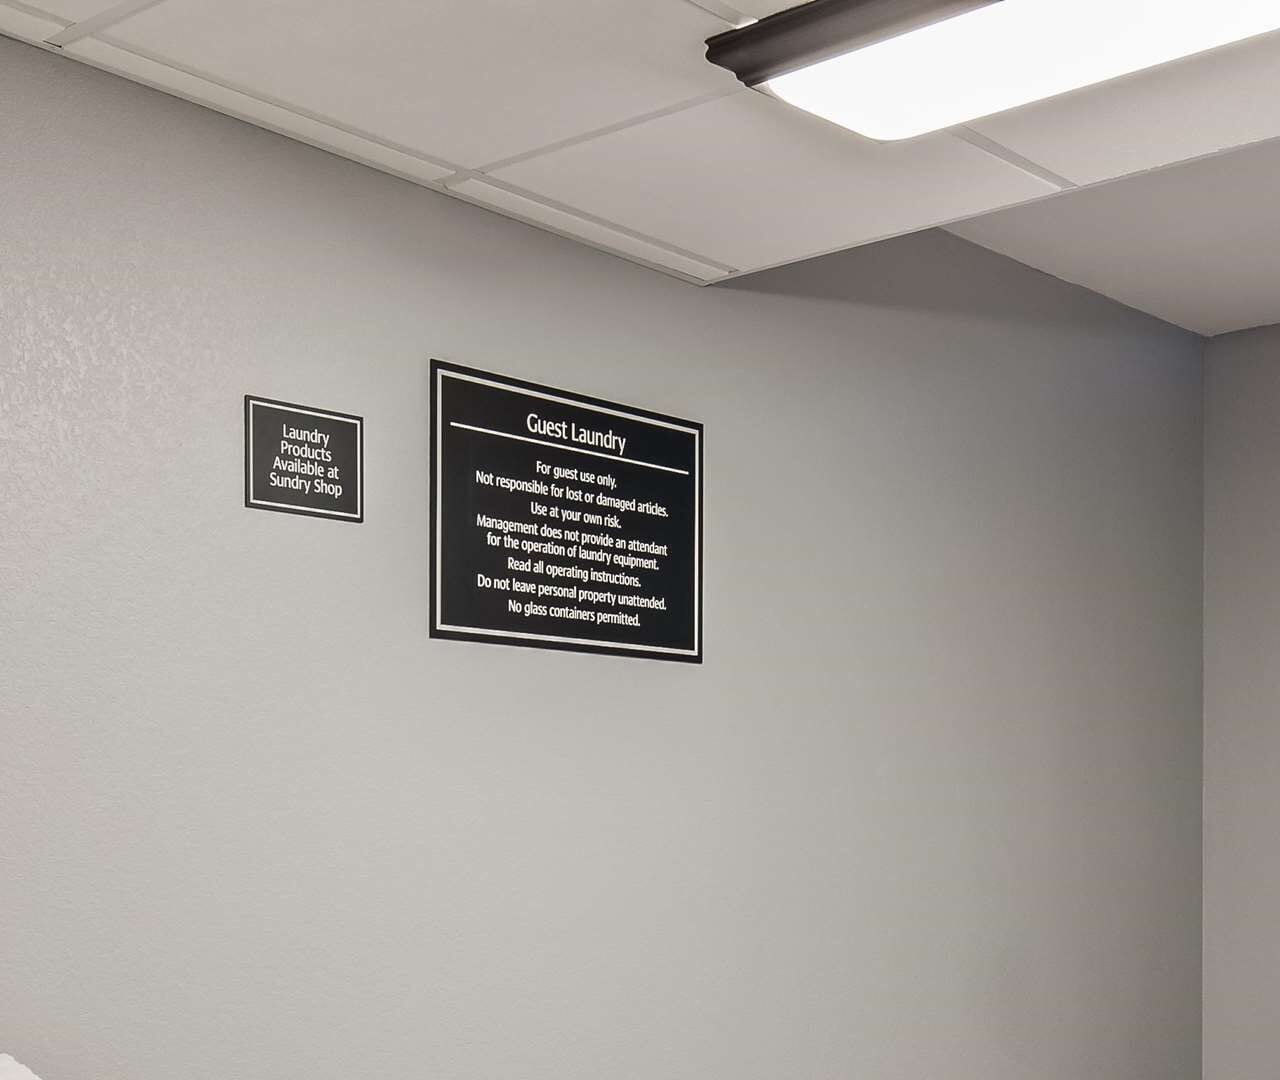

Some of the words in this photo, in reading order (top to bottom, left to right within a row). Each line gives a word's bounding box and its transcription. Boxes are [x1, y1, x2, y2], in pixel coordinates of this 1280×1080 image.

[283, 424, 329, 448] Laundry
[526, 413, 567, 440] Guest
[571, 422, 626, 454] Laundry
[281, 441, 332, 461] Products
[273, 456, 324, 477] Available
[328, 466, 339, 480] at
[536, 461, 551, 475] For
[553, 466, 578, 482] guest
[580, 471, 595, 483] use
[597, 474, 617, 489] only.
[270, 472, 311, 494] Sundry
[314, 479, 342, 498] Shop
[476, 470, 494, 486] Not
[496, 475, 548, 496] responsible
[550, 484, 564, 498] for
[566, 487, 582, 502] lost
[584, 492, 594, 503] or
[596, 492, 636, 512] damaged
[637, 500, 668, 517] articles.
[530, 502, 548, 516] Use
[550, 506, 560, 518] at
[561, 509, 581, 523] your
[583, 512, 602, 526] own
[604, 514, 622, 528] risk.
[476, 514, 539, 536] Management
[540, 524, 562, 538] does
[564, 528, 580, 541] not
[581, 532, 614, 549] provide
[615, 537, 626, 549] an
[628, 537, 668, 556] attendant
[487, 532, 502, 546] for
[503, 534, 519, 549] the
[521, 539, 565, 558] operation
[567, 545, 578, 558] of
[579, 546, 612, 565] laundry
[613, 554, 659, 571] equipment.
[508, 558, 531, 572] Read
[533, 561, 544, 574] all
[546, 564, 588, 582] operating
[590, 568, 641, 588] instructions.
[477, 574, 492, 588] Do
[494, 577, 510, 590] not
[512, 579, 536, 594] leave
[538, 582, 577, 601] personal
[579, 590, 616, 605] property
[618, 591, 666, 610] unattended.
[508, 600, 522, 612] No
[524, 602, 547, 618] glass
[549, 605, 595, 621] containers
[597, 610, 640, 626] permitted.
